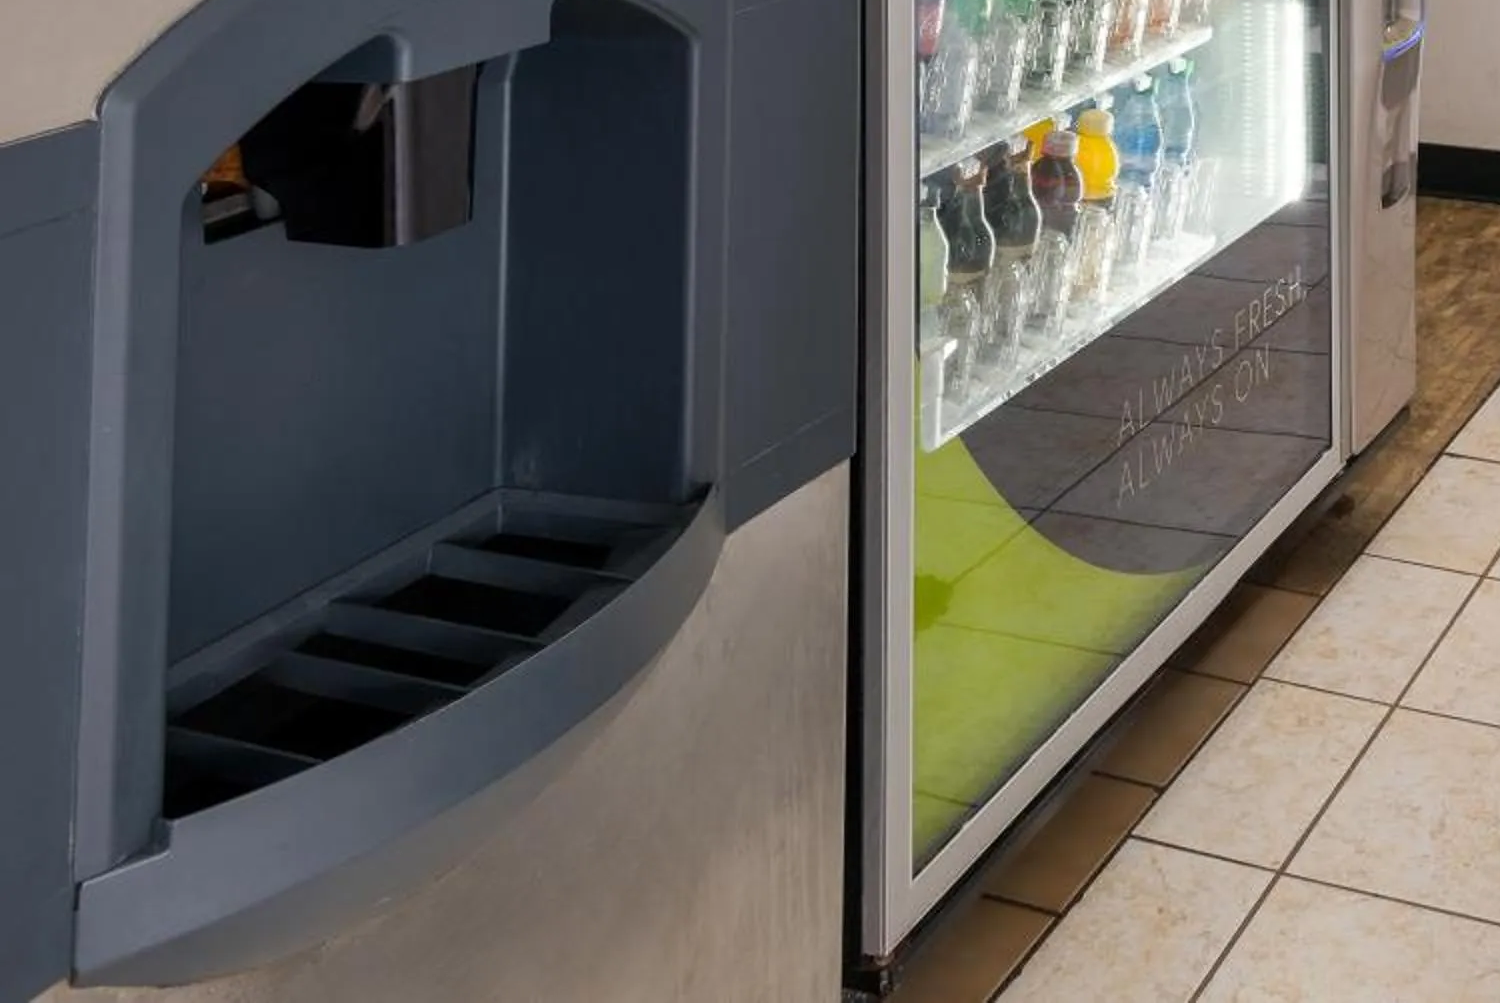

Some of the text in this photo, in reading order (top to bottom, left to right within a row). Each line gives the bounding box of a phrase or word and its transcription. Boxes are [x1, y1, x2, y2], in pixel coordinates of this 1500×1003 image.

[1116, 328, 1223, 447] ALWAYS
[1116, 342, 1271, 509] ALWAYS ON
